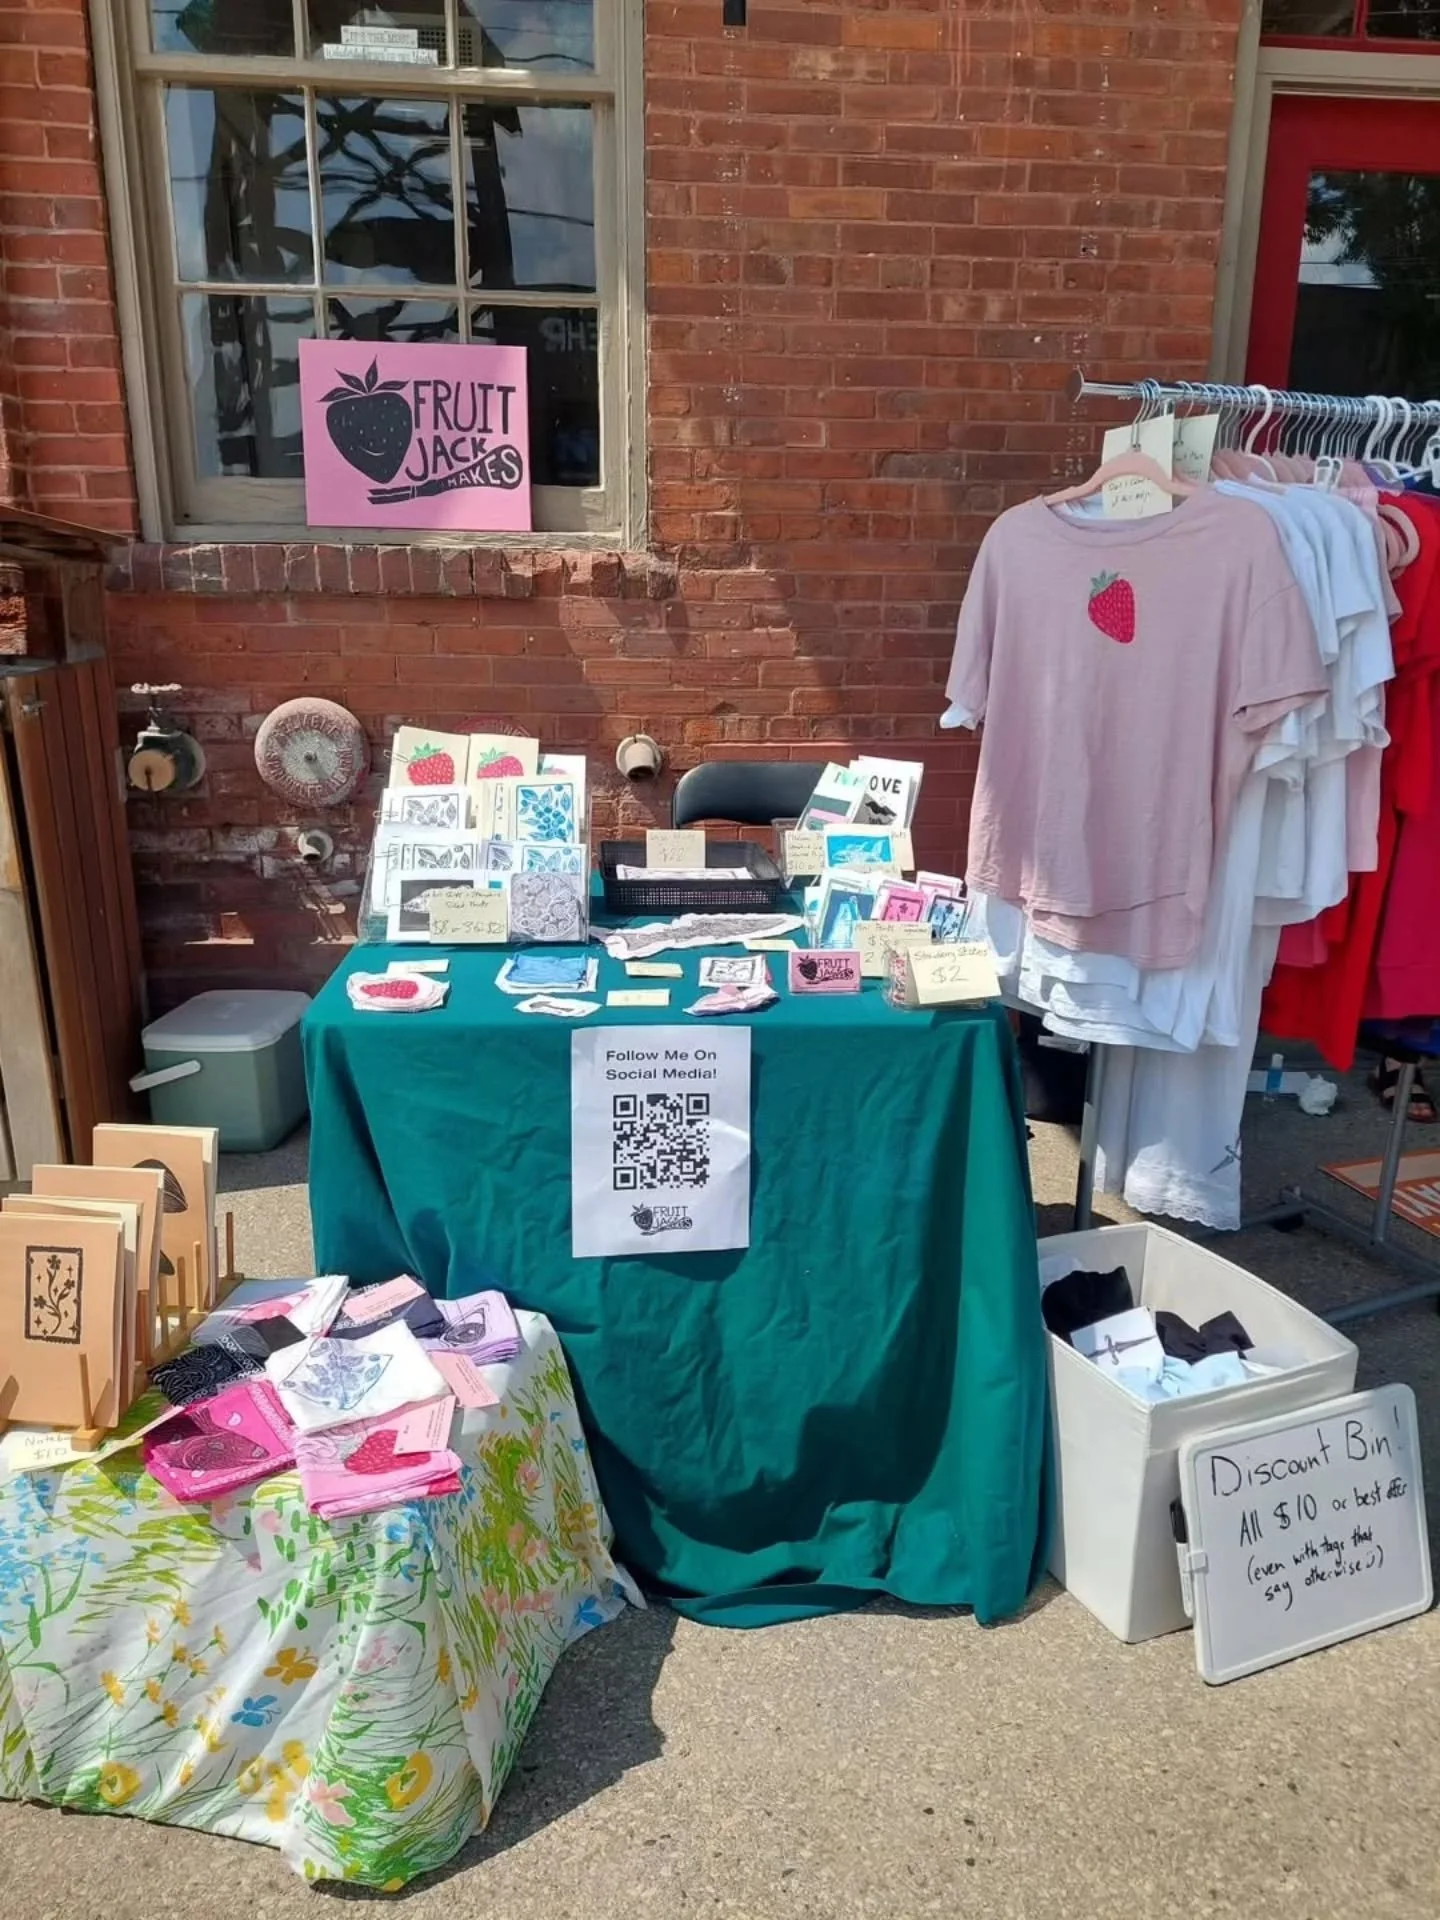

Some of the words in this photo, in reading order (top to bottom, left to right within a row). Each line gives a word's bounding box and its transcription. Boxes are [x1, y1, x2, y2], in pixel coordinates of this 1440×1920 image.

[413, 380, 516, 435] FRUIT
[405, 435, 487, 482] JACK
[447, 449, 520, 487] MAKES
[818, 958, 851, 969] FRUIT
[931, 964, 969, 984] $2
[606, 1049, 659, 1062] Follow
[664, 1049, 689, 1061] Me
[694, 1049, 718, 1061] On
[606, 1068, 658, 1081] Social
[663, 1068, 718, 1080] Media!
[653, 1205, 688, 1217] FRUIT
[1211, 1427, 1331, 1497] Discount
[1345, 1405, 1402, 1462] Bin!
[1239, 1509, 1263, 1548] All
[1273, 1493, 1317, 1531] $10
[1332, 1498, 1348, 1512] or
[1353, 1480, 1382, 1508] best
[1247, 1554, 1287, 1586] (even
[1292, 1540, 1320, 1566] with
[1320, 1535, 1346, 1568] tags
[1351, 1525, 1374, 1548] that
[1264, 1580, 1294, 1612] say
[1304, 1559, 1363, 1588] otherwise
